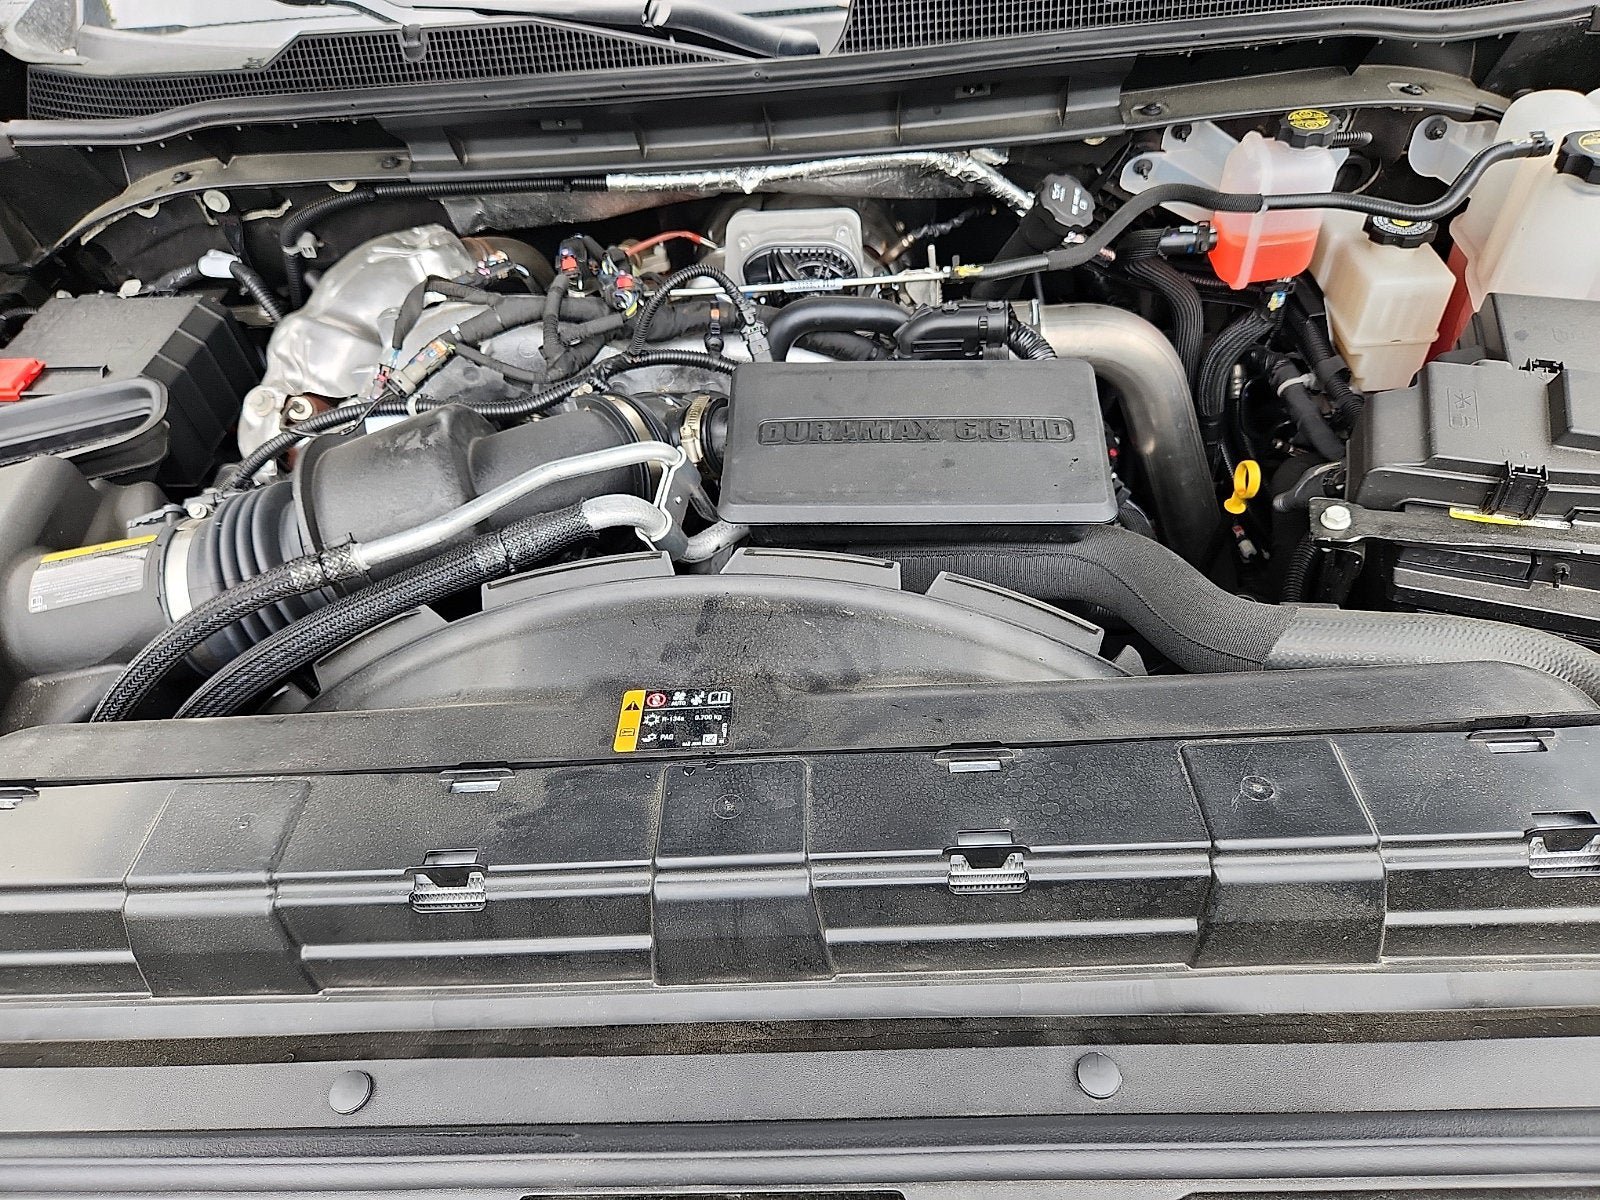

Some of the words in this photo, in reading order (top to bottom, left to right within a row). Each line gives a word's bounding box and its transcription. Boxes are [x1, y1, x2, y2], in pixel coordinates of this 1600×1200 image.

[762, 420, 942, 443] DURAMAX
[955, 419, 1012, 441] 6.6
[1020, 419, 1072, 441] HD
